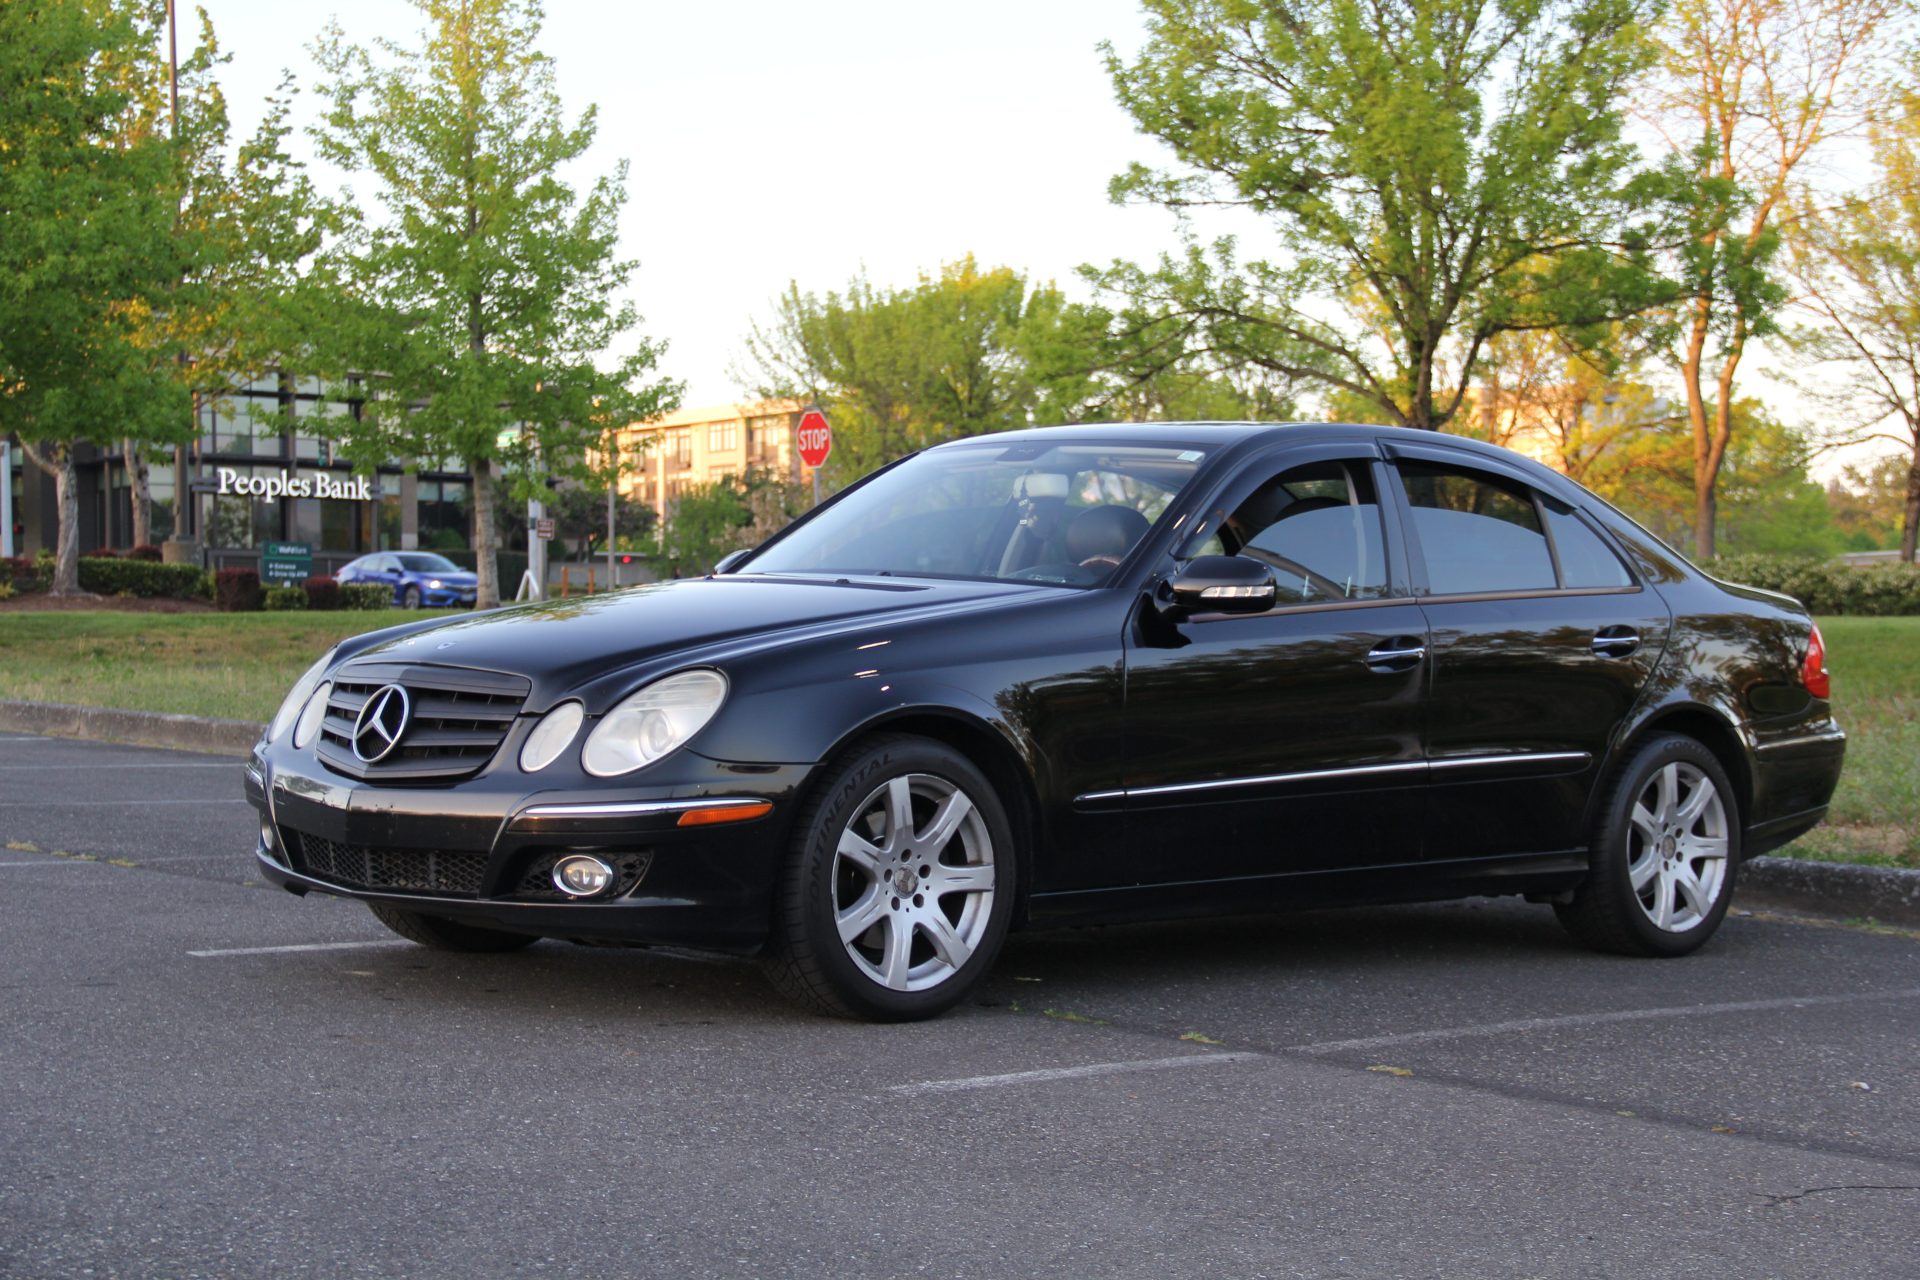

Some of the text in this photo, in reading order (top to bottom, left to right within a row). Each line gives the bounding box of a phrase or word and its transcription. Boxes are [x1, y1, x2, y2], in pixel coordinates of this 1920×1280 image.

[799, 429, 828, 451] STOP
[217, 467, 372, 504] Peoples Bank
